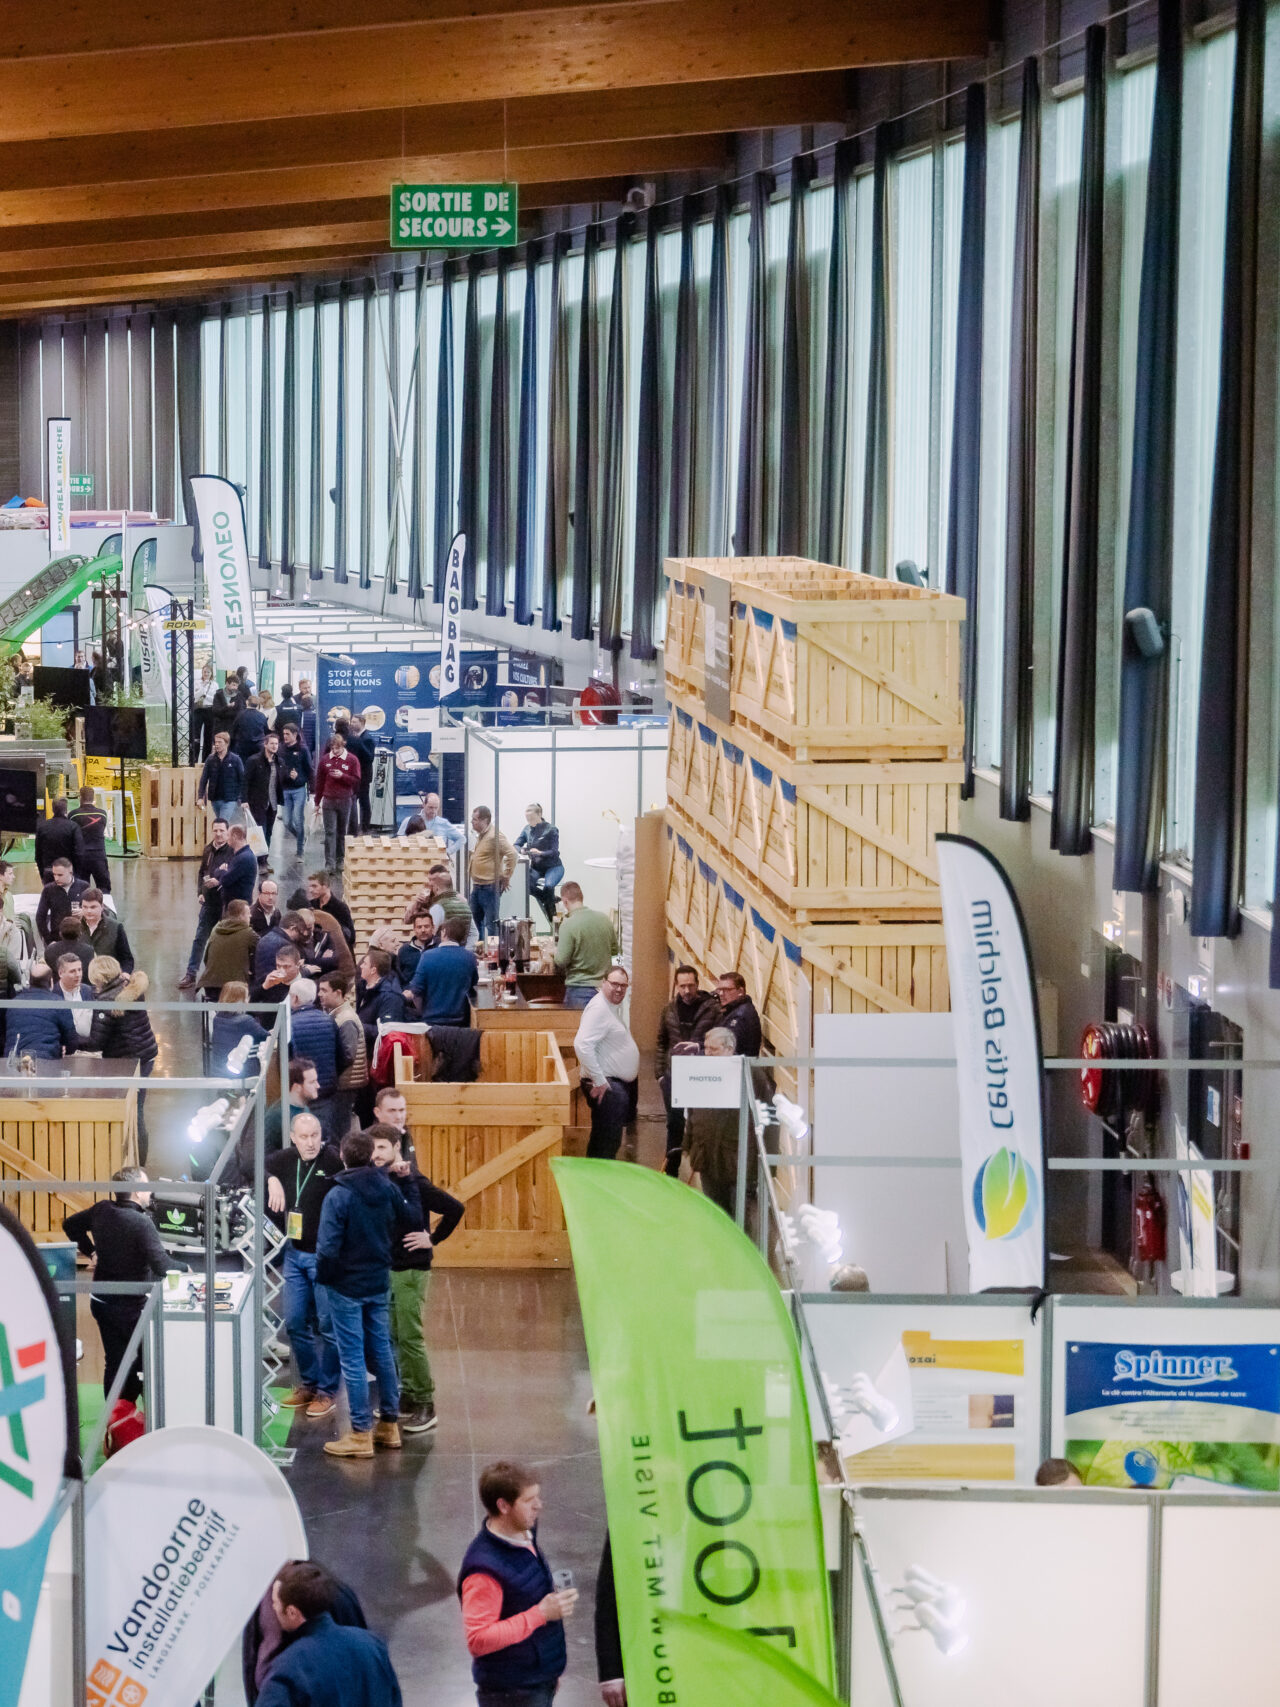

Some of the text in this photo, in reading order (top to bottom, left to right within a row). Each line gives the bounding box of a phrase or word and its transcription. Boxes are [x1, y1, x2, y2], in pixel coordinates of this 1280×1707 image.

[399, 191, 510, 213] SORTIE DE
[399, 217, 488, 238] SECOURS
[166, 621, 198, 630] ROPA
[444, 547, 462, 683] BAOBAG
[1114, 1350, 1233, 1380] Spinner
[106, 1497, 206, 1655] Vandoorne
[194, 1524, 240, 1598] POELKAPELLE
[128, 1509, 226, 1670] installatiebedrijf
